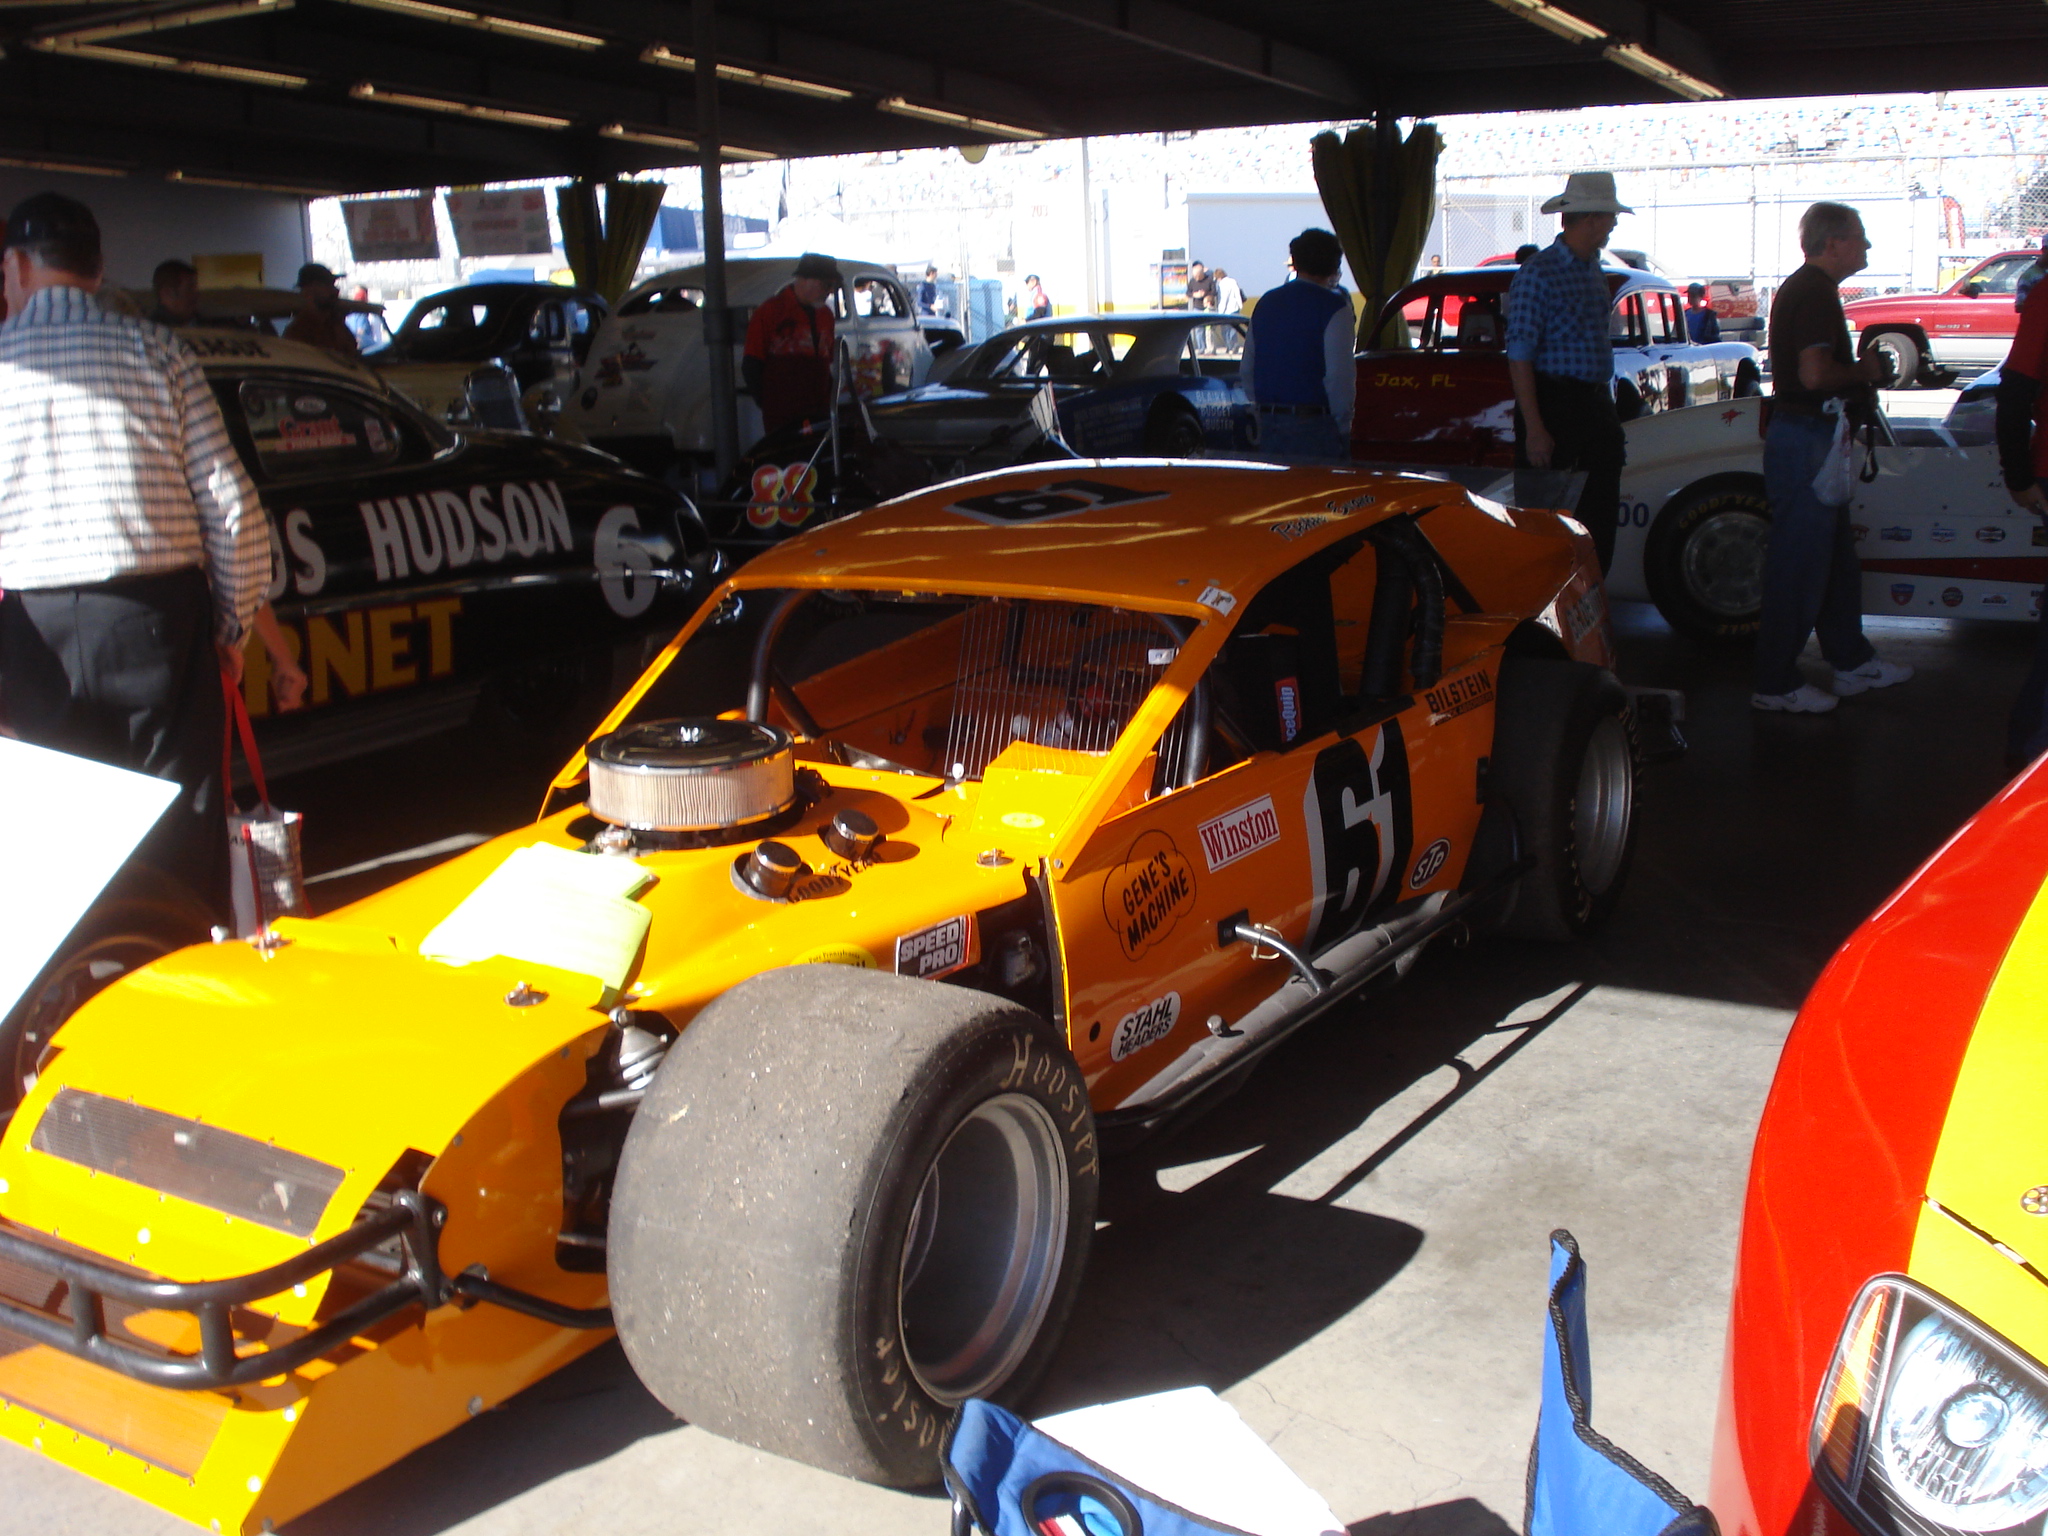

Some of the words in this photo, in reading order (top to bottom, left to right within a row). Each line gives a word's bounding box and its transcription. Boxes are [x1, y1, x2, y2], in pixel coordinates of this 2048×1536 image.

[1375, 373, 1420, 389] Jax,
[1430, 374, 1457, 388] FL
[747, 462, 818, 529] 88
[943, 479, 1171, 526] 61
[1617, 502, 1649, 528] 00
[358, 478, 574, 582] HUDSON
[593, 506, 657, 618] 6
[1717, 621, 1760, 635] AGLE
[1281, 686, 1297, 742] ceQuip
[1424, 668, 1492, 714] BILSTEIN
[1201, 808, 1278, 865] Winston
[1303, 717, 1414, 956] 61
[1122, 851, 1172, 917] GENE'S
[1413, 844, 1445, 882] STP
[1127, 867, 1190, 951] MACHINE
[901, 921, 960, 962] SPEED
[919, 943, 958, 975] PRO
[1117, 1018, 1172, 1057] HEADERS
[1120, 997, 1173, 1042] STAHL
